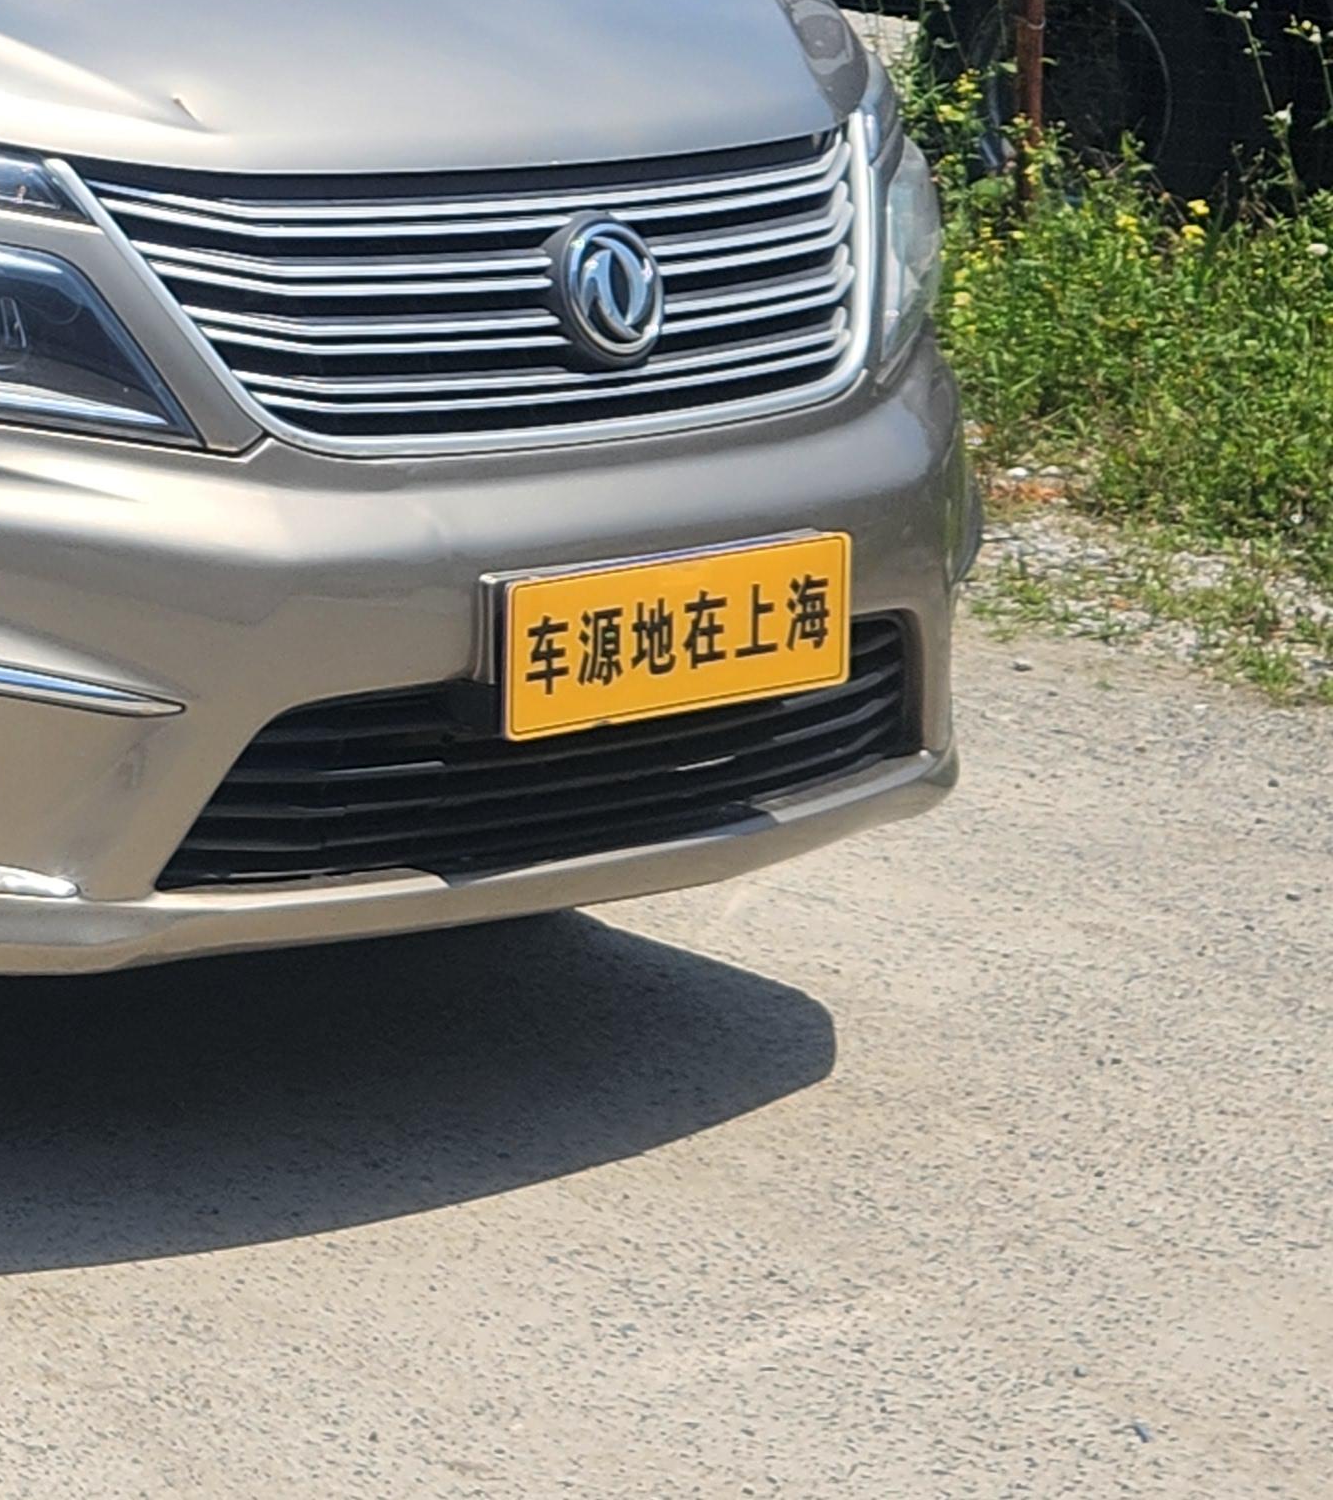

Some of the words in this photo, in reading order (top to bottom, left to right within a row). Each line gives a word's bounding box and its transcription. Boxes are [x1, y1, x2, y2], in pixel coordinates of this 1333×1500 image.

[526, 574, 829, 694] 车源地在上海
